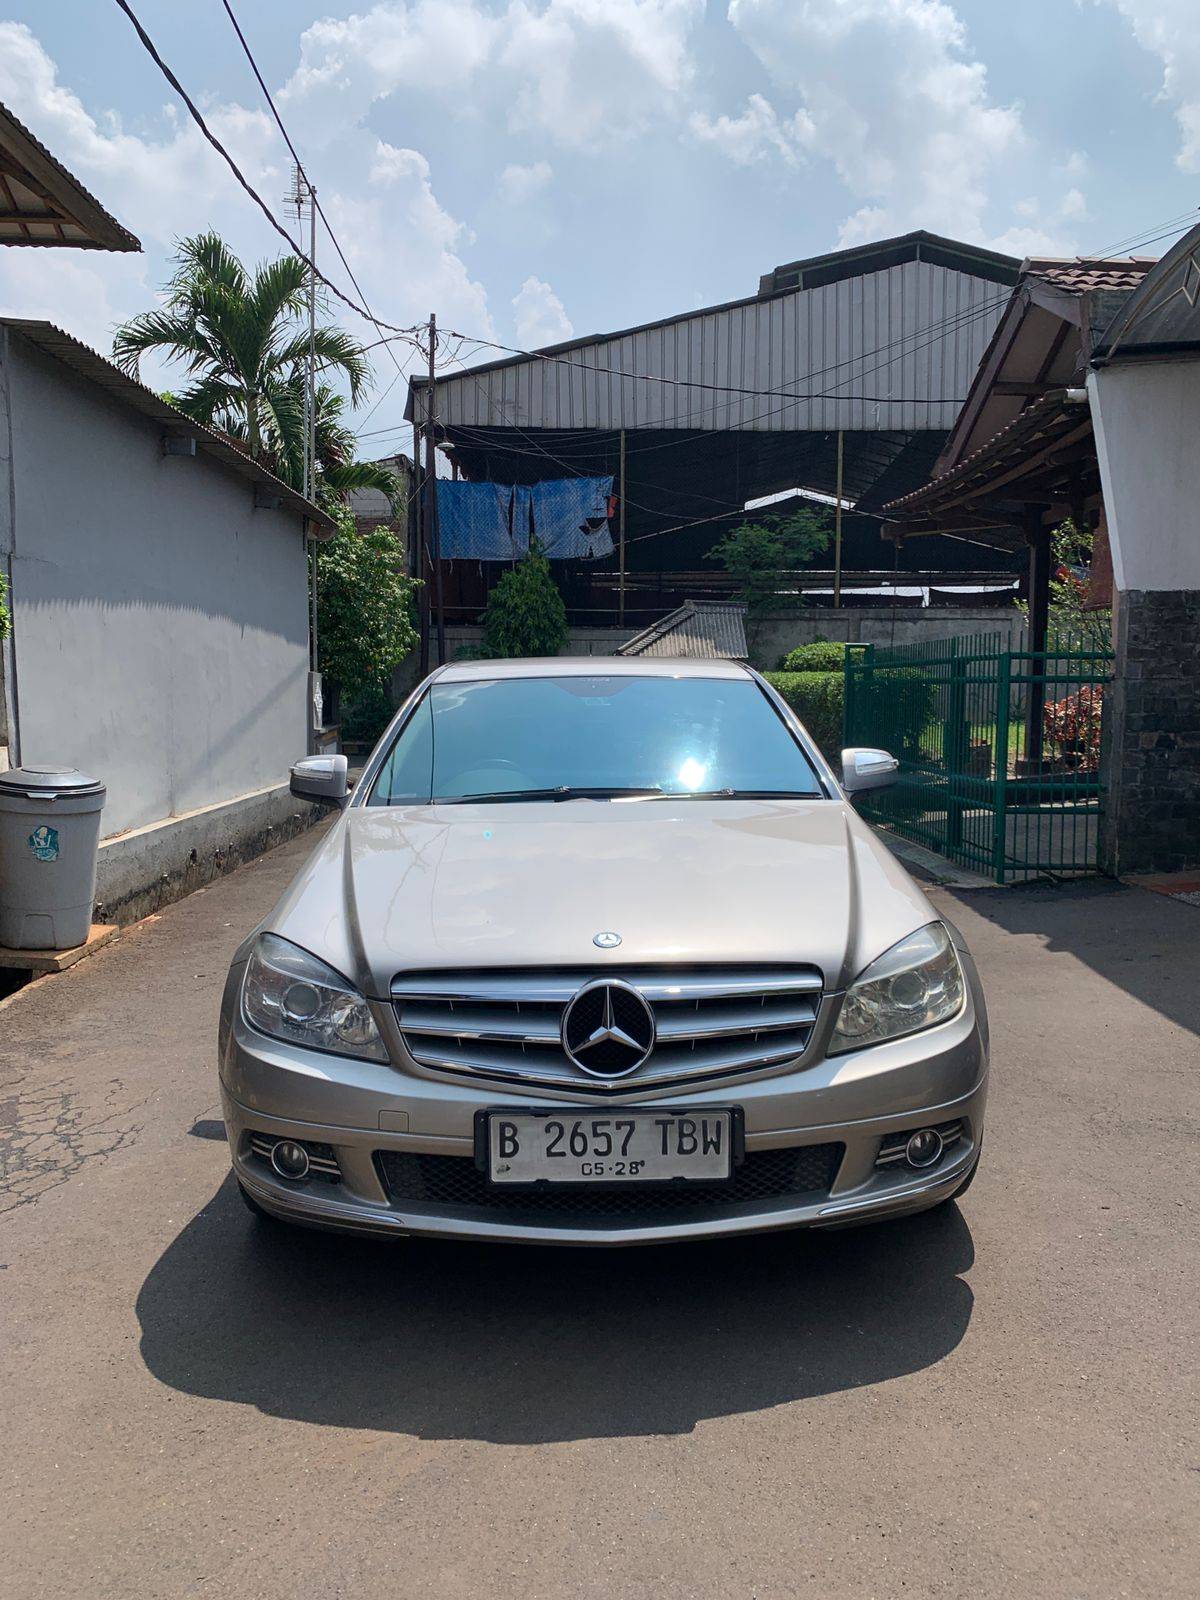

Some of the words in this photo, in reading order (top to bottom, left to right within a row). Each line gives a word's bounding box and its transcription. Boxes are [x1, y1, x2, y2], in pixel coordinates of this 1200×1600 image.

[499, 1121, 519, 1158] B
[544, 1120, 636, 1158] 2657
[655, 1119, 721, 1156] TBW
